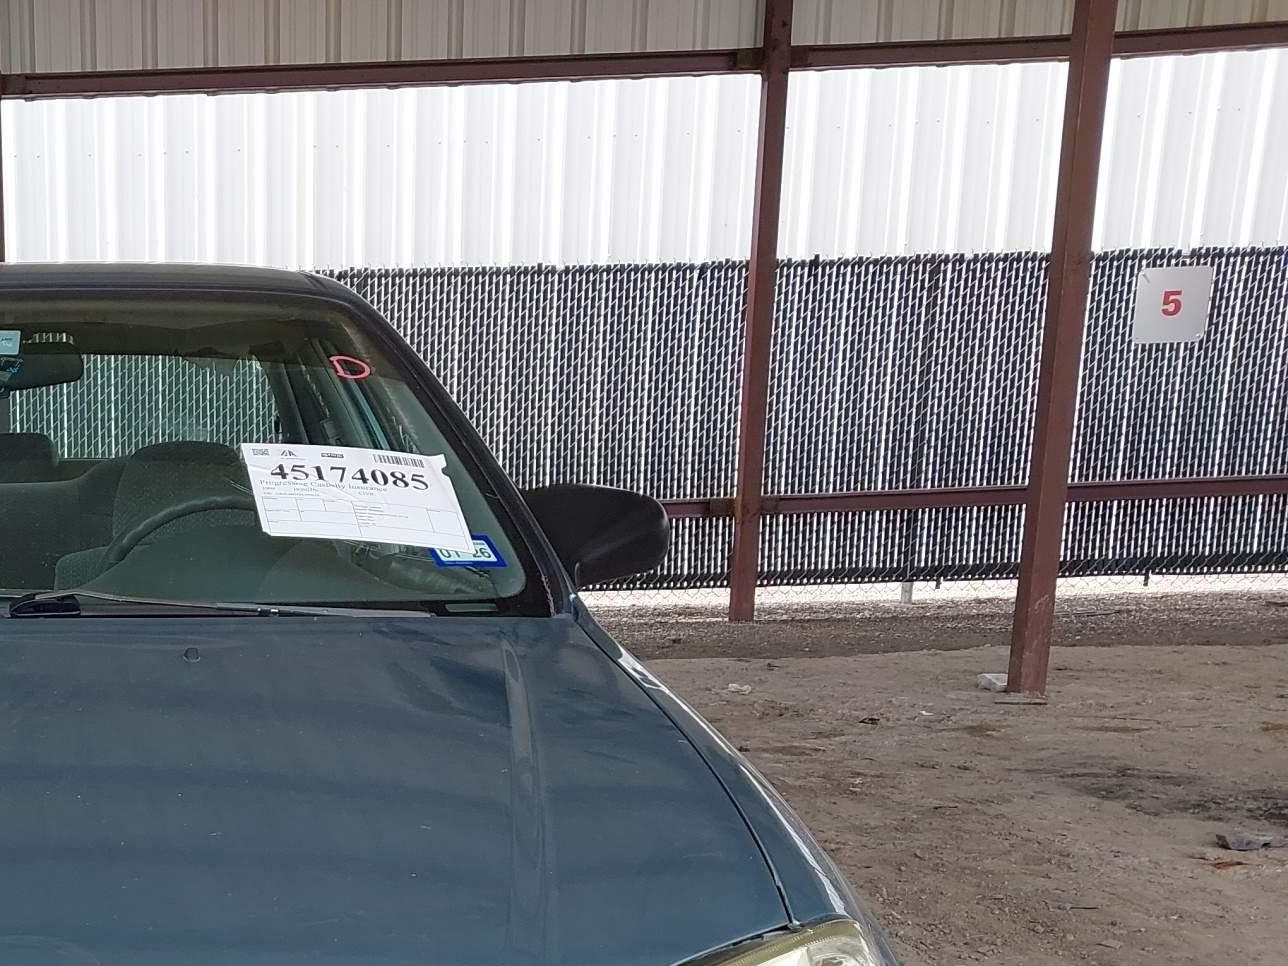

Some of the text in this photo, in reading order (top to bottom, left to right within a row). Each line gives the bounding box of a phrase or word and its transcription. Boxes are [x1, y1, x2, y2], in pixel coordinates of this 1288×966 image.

[1161, 290, 1182, 317] 5
[328, 355, 371, 379] D
[270, 463, 429, 491] 45174085
